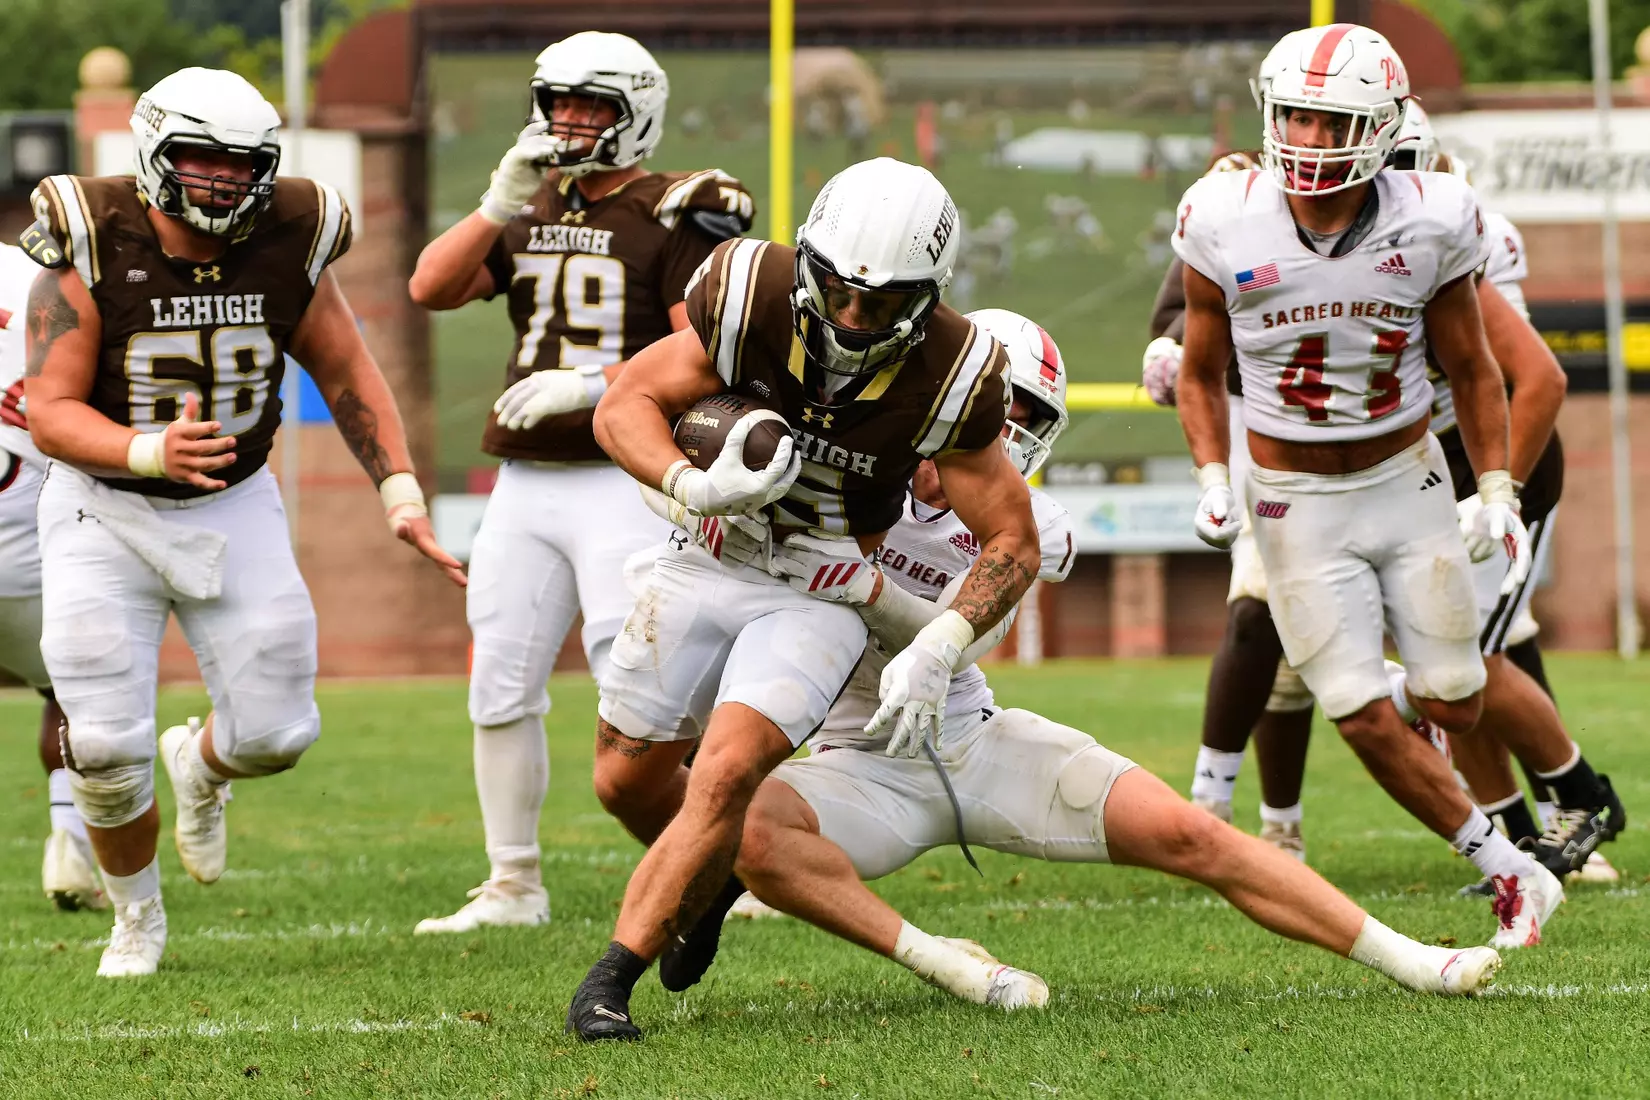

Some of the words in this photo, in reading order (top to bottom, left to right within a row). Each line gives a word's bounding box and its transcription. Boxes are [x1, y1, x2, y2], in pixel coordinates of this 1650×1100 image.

[526, 224, 614, 255] LEHIGH
[1374, 264, 1412, 276] adidas
[150, 294, 265, 327] LEHIGH
[511, 253, 626, 369] 79
[1262, 301, 1344, 329] SACRED
[124, 325, 275, 438] 68
[1276, 331, 1411, 426] 43
[684, 411, 720, 429] Wilson
[792, 427, 878, 477] HIGH
[1021, 444, 1041, 460] Ridde
[1256, 499, 1291, 519] SHU
[948, 536, 979, 557] adidas
[907, 560, 949, 589] HEA
